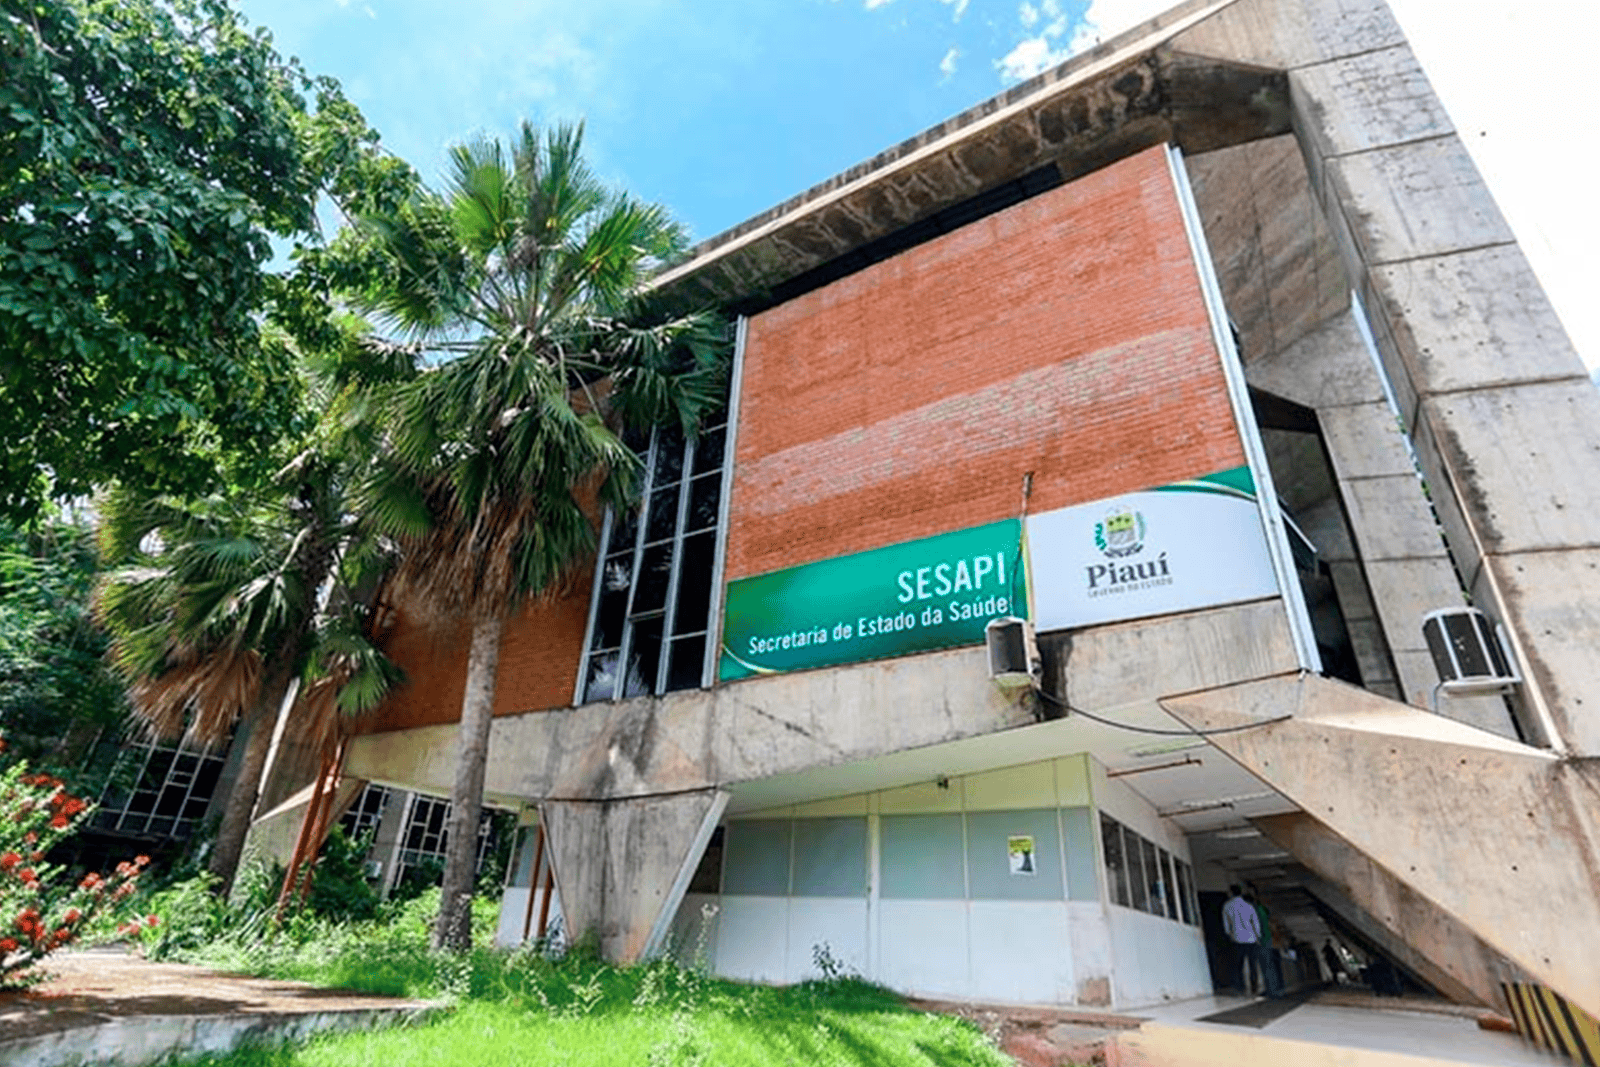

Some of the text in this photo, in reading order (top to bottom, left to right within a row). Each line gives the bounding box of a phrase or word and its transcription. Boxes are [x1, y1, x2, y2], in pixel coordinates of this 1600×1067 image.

[898, 551, 1005, 603] SESAPI
[1085, 551, 1170, 588] Piauí
[748, 595, 1009, 655] Secretaria de Estado da Saúde
